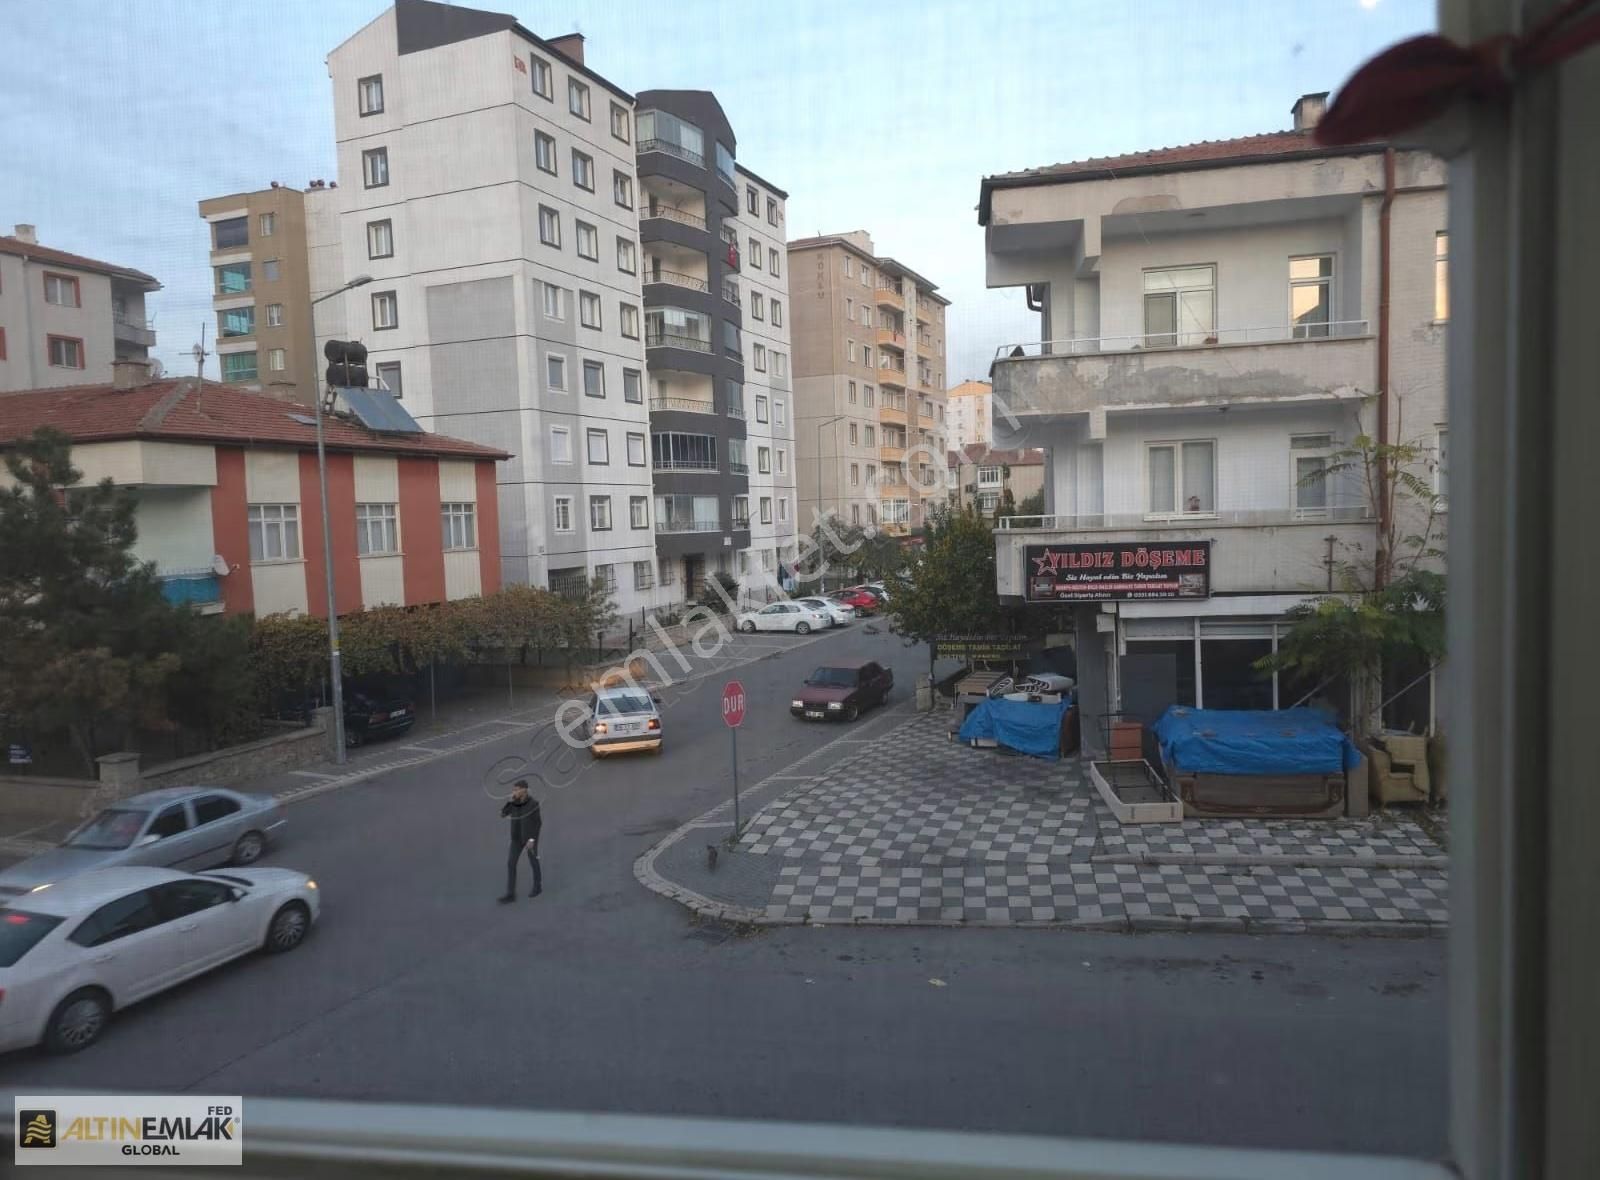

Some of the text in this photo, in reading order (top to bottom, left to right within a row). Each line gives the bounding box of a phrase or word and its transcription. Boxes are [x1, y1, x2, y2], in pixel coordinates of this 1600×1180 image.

[1048, 547, 1206, 570] YILDIZ DÖŞEME
[723, 694, 744, 715] DUR
